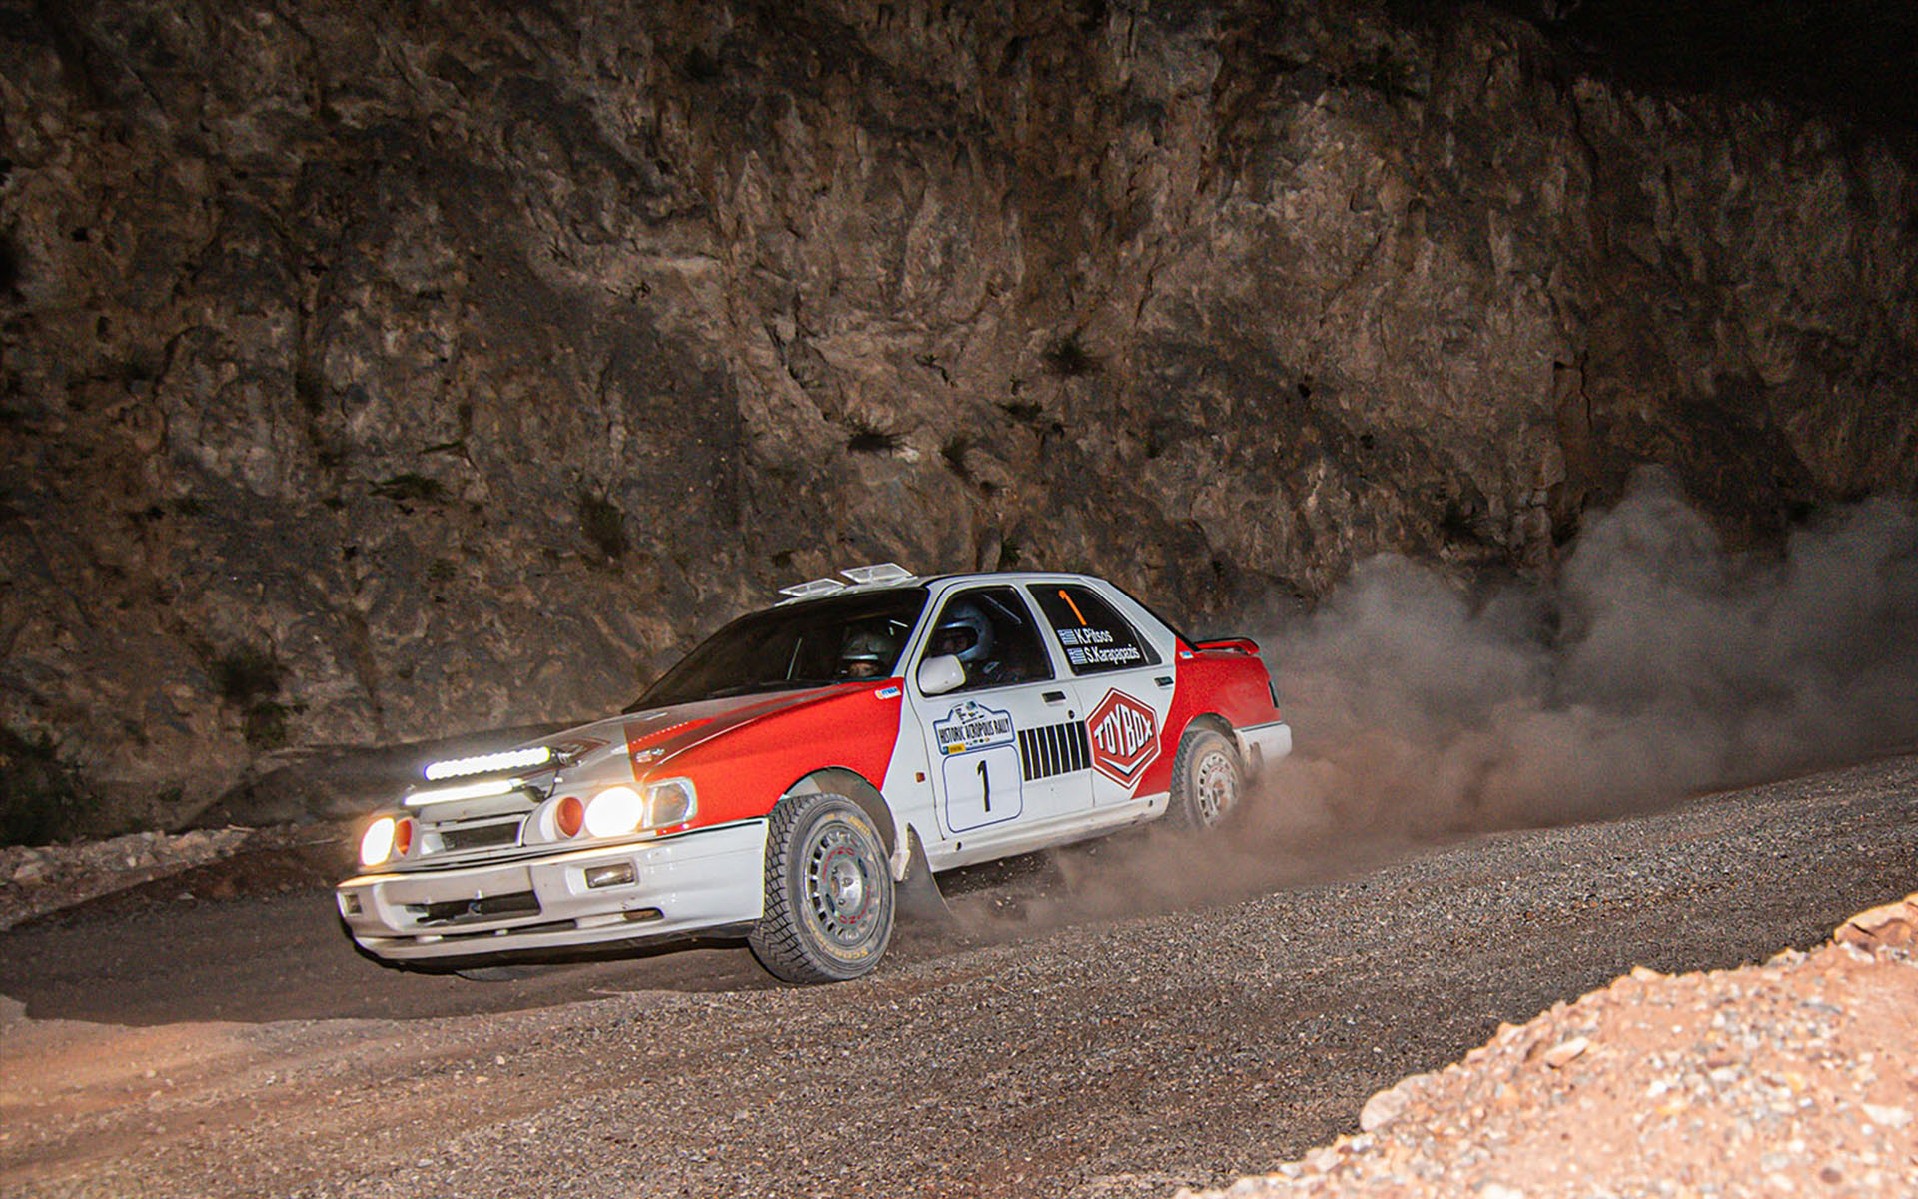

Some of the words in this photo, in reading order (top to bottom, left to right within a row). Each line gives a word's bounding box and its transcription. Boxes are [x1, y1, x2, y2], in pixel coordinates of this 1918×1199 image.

[1058, 590, 1087, 626] 1
[1074, 627, 1113, 644] K.Pitsos
[938, 725, 966, 744] HISTORIC
[965, 719, 995, 740] ACROPOLIS
[993, 718, 1011, 735] RALLY
[1094, 703, 1154, 757] TOYBOX
[976, 760, 991, 812] 1
